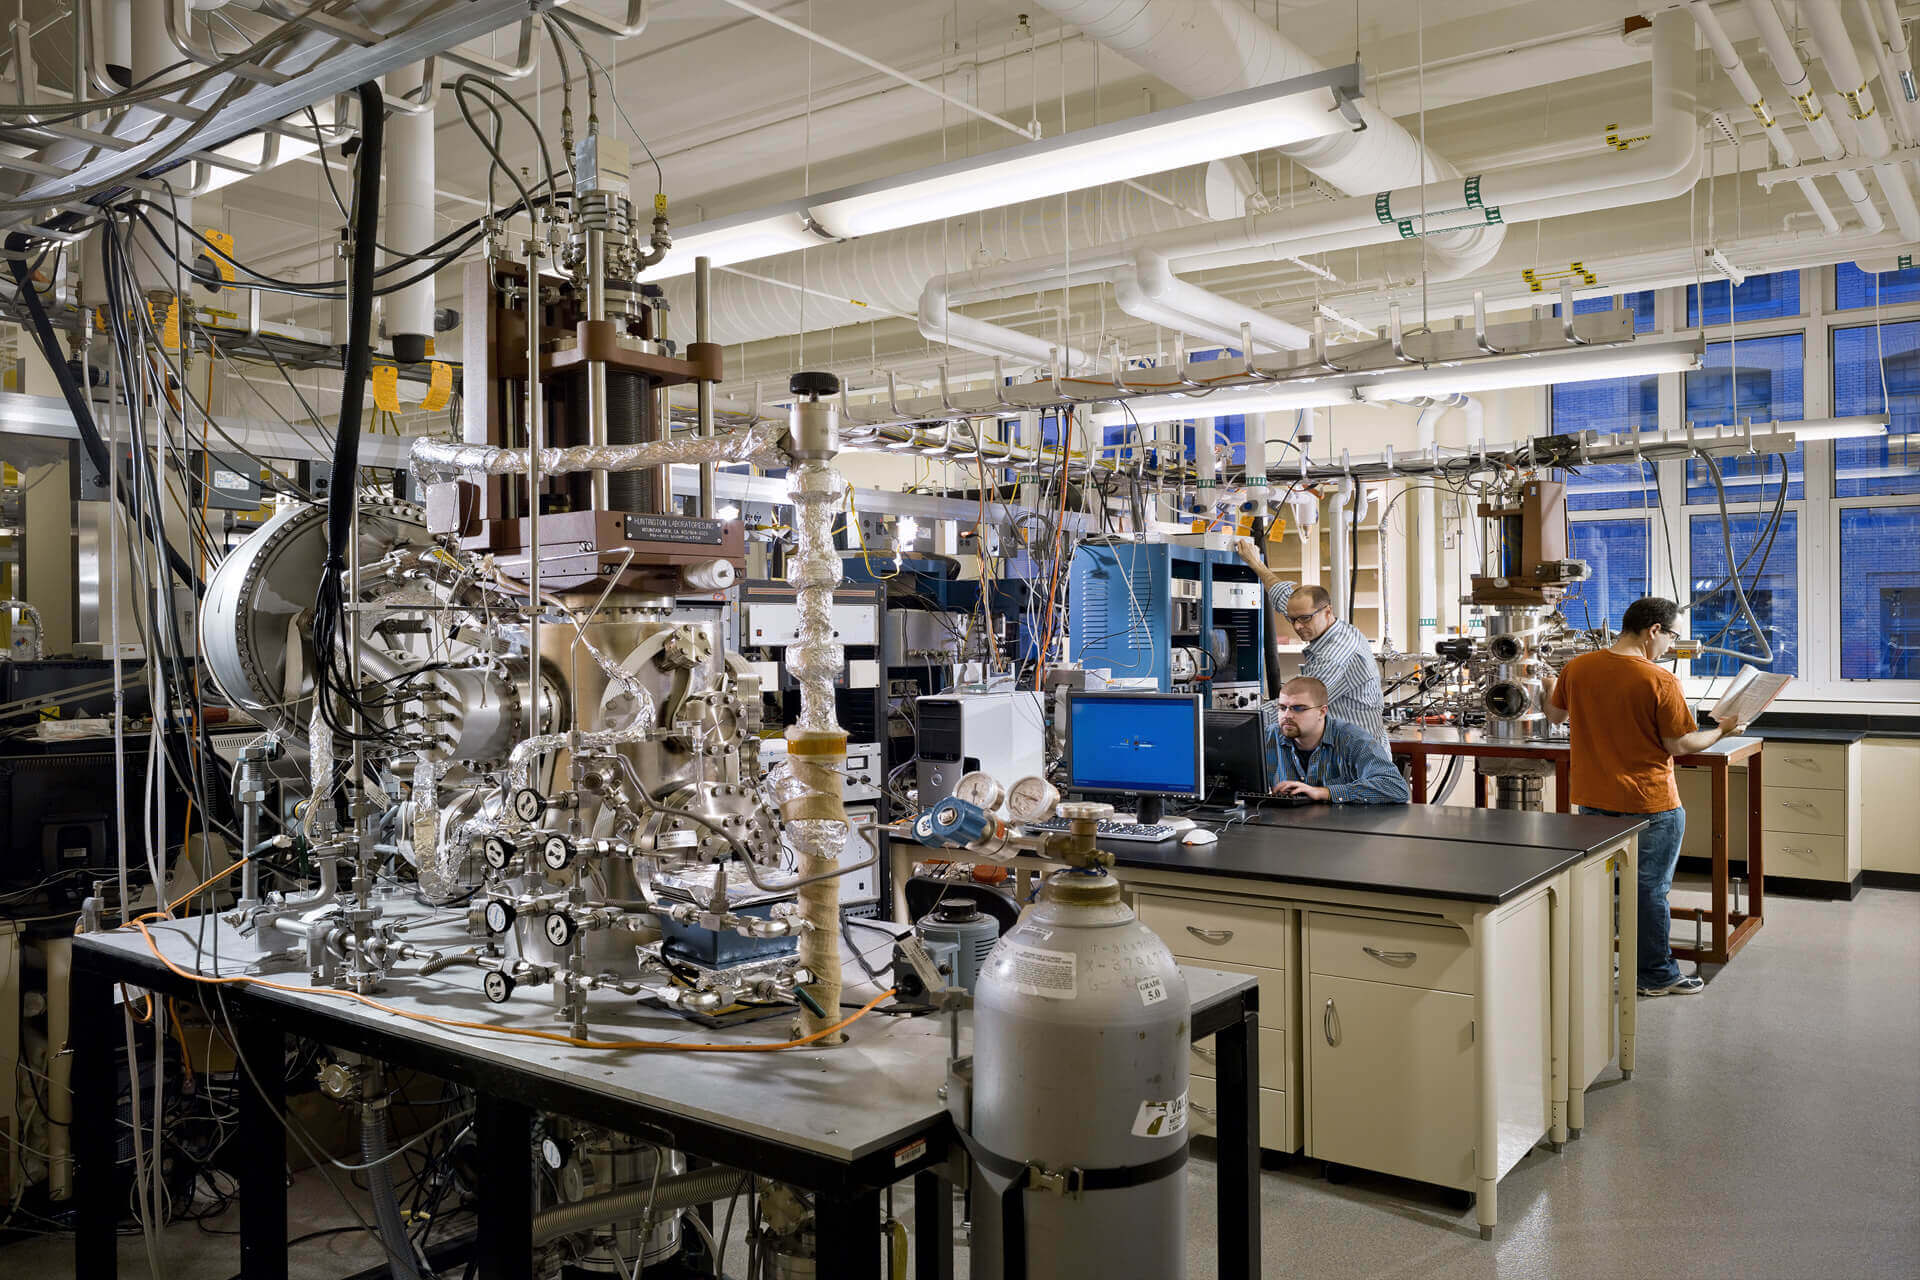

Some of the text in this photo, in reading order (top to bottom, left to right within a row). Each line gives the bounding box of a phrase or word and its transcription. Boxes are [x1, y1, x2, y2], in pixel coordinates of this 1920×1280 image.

[634, 518, 667, 527] HUNTINGTON
[1139, 979, 1161, 991] GRADE
[1147, 989, 1161, 1001] 5.0
